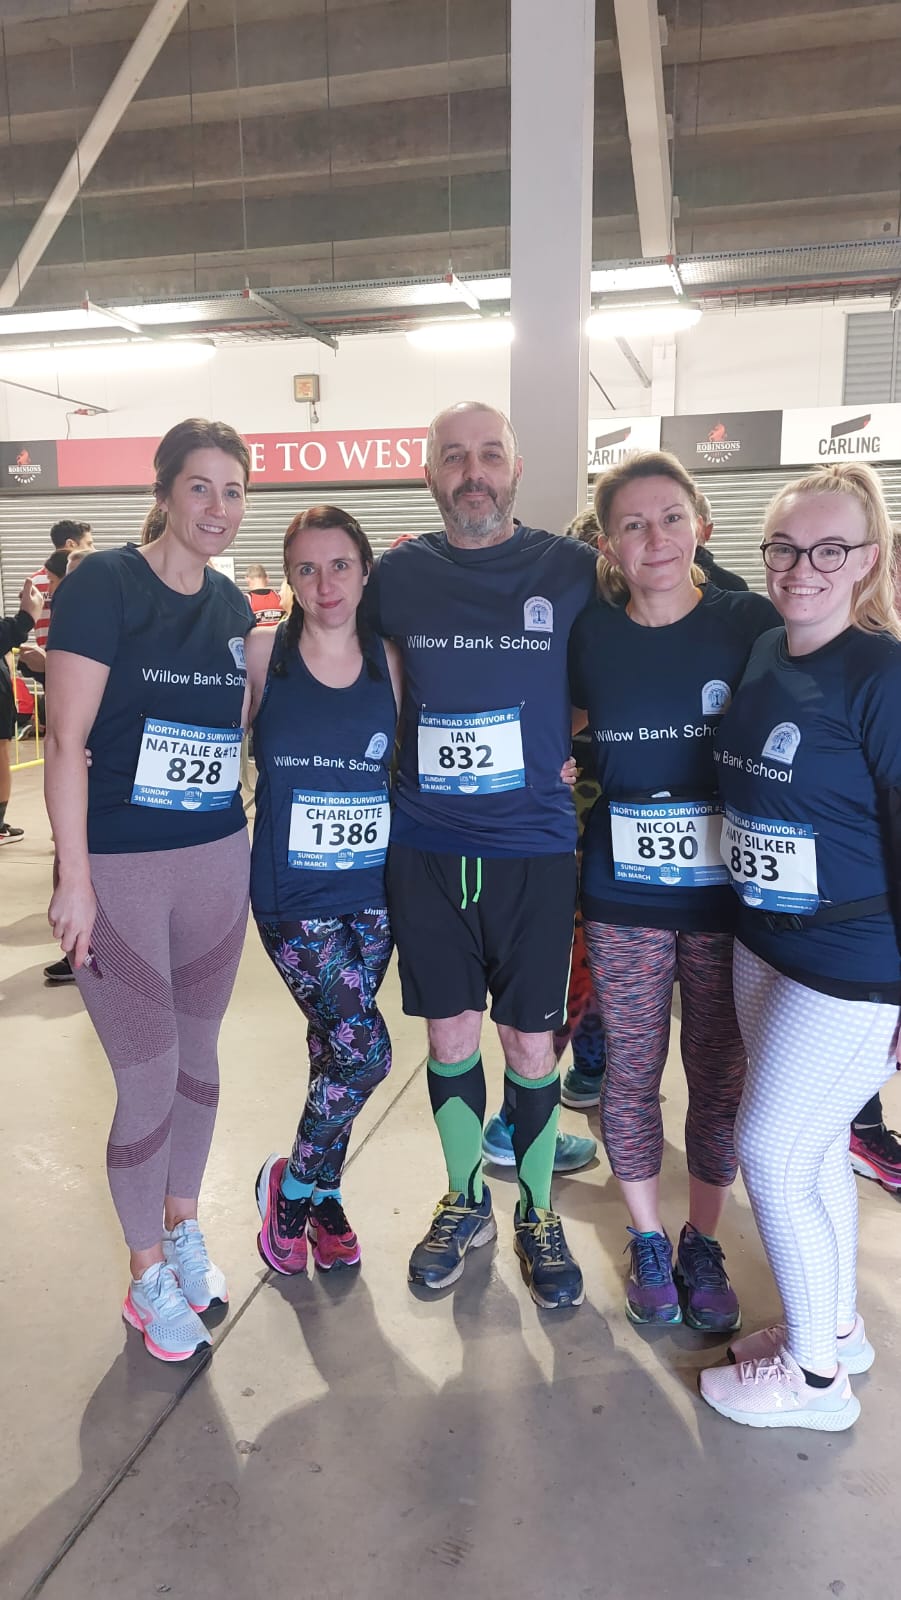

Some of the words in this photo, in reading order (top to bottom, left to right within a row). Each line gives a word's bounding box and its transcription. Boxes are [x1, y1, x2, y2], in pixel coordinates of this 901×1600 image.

[275, 441, 327, 472] TO
[336, 437, 428, 470] WEST
[696, 441, 741, 451] ROBINSONS
[818, 436, 881, 456] CARLING
[407, 634, 448, 649] Willow
[453, 635, 493, 649] Bank
[500, 635, 551, 651] School
[142, 667, 190, 684] Willow
[193, 671, 222, 686] Bank
[464, 714, 505, 727] SURVIVOR
[147, 723, 179, 736] NORTH
[181, 728, 205, 740] ROAD
[450, 731, 476, 743] IAN
[594, 729, 634, 743] Willow
[639, 726, 678, 741] Bank
[145, 737, 211, 758] NATALIE
[273, 755, 309, 767] Willow
[313, 755, 345, 769] Bank
[348, 759, 381, 772] School
[438, 744, 494, 770] 832
[166, 757, 222, 785] 828
[722, 750, 744, 770] Bank
[745, 758, 793, 783] School
[140, 787, 170, 797] SUNDAY
[298, 794, 327, 804] NORTH
[328, 797, 351, 805] ROAD
[146, 796, 173, 806] MARCH
[306, 807, 383, 821] CHARLOTTE
[612, 806, 639, 817] NORTH
[640, 808, 667, 817] ROAD
[668, 805, 713, 817] SURVIVOR
[311, 821, 378, 846] 1386
[636, 820, 697, 834] NICOLA
[750, 821, 796, 836] SURVIVOR
[637, 836, 699, 860] 830
[744, 834, 796, 855] SILKER
[297, 852, 323, 860] SUNDAY
[303, 860, 328, 868] MARCH
[730, 845, 779, 882] 833
[620, 863, 646, 872] SUNDAY
[628, 872, 651, 881] MARCH
